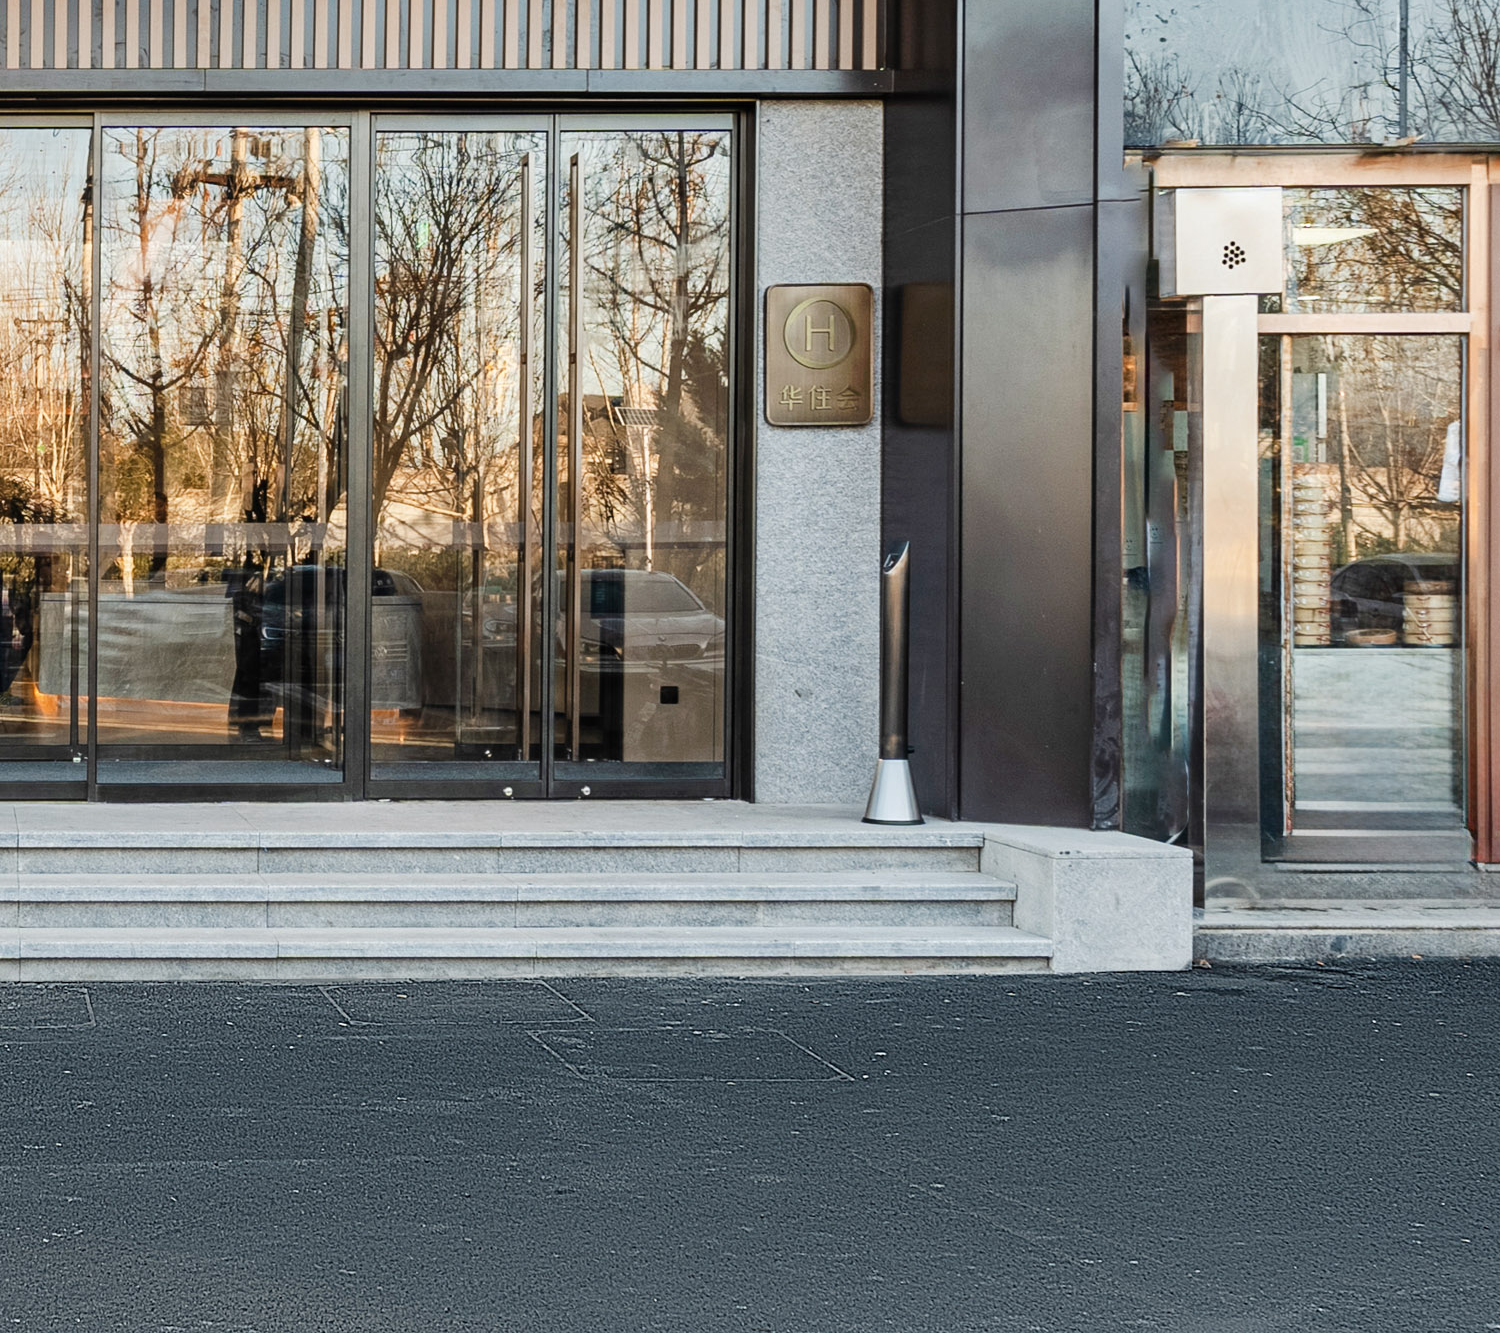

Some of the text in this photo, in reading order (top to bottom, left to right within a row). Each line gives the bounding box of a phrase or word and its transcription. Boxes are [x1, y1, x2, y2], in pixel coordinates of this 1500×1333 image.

[804, 314, 836, 352] H
[779, 384, 862, 412] 华住会
